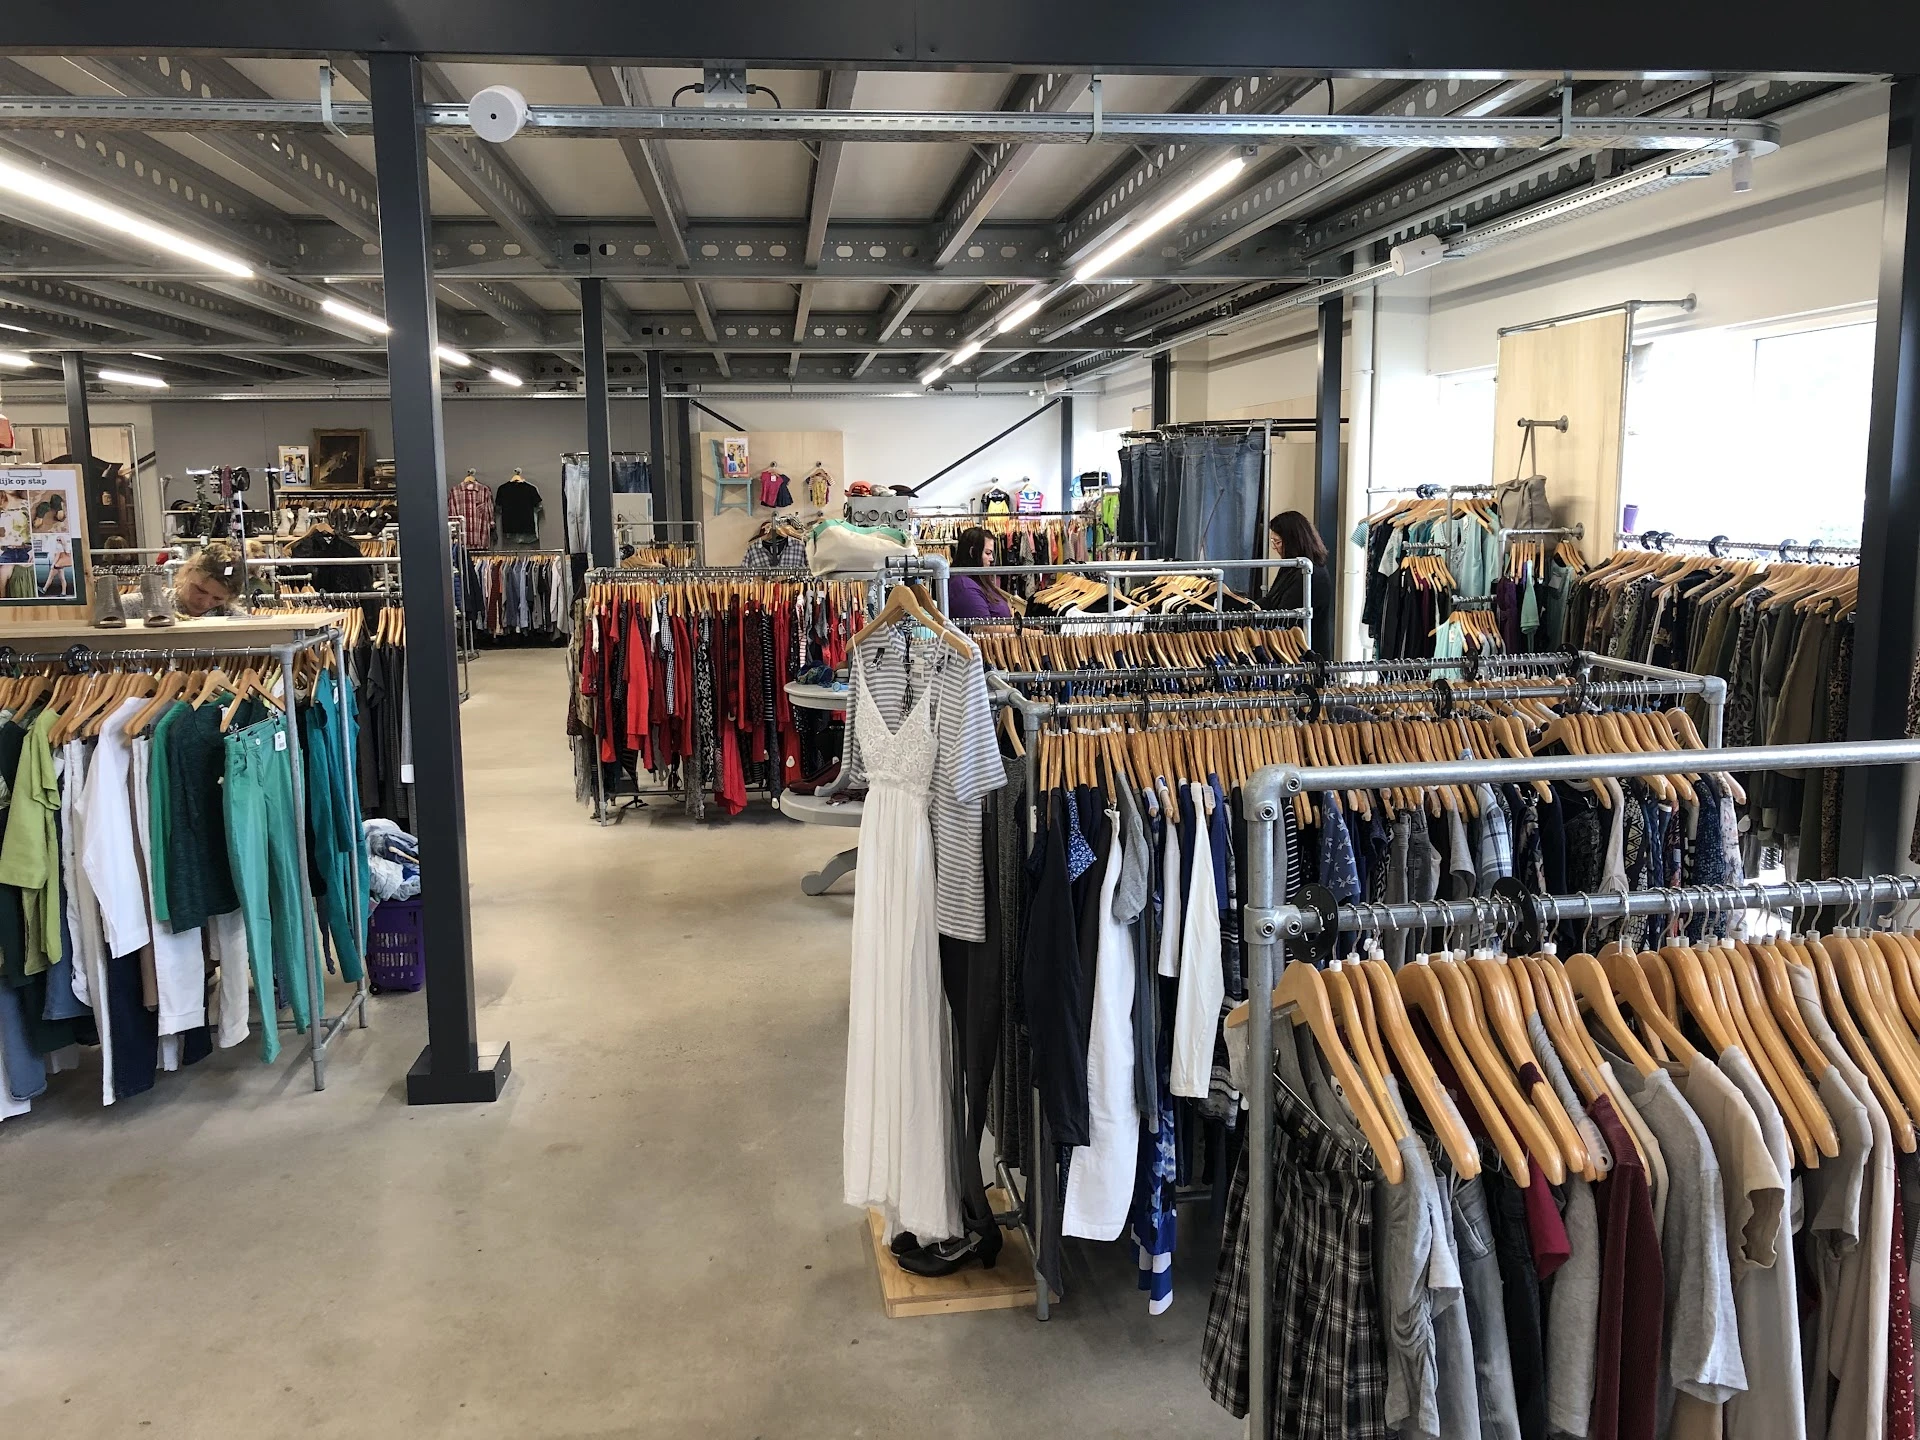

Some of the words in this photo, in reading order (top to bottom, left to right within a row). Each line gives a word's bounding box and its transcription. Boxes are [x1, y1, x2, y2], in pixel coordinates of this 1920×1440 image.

[28, 478, 47, 486] stap
[1305, 890, 1312, 901] S
[1517, 889, 1526, 902] M
[1326, 912, 1335, 921] S
[1310, 947, 1317, 958] S
